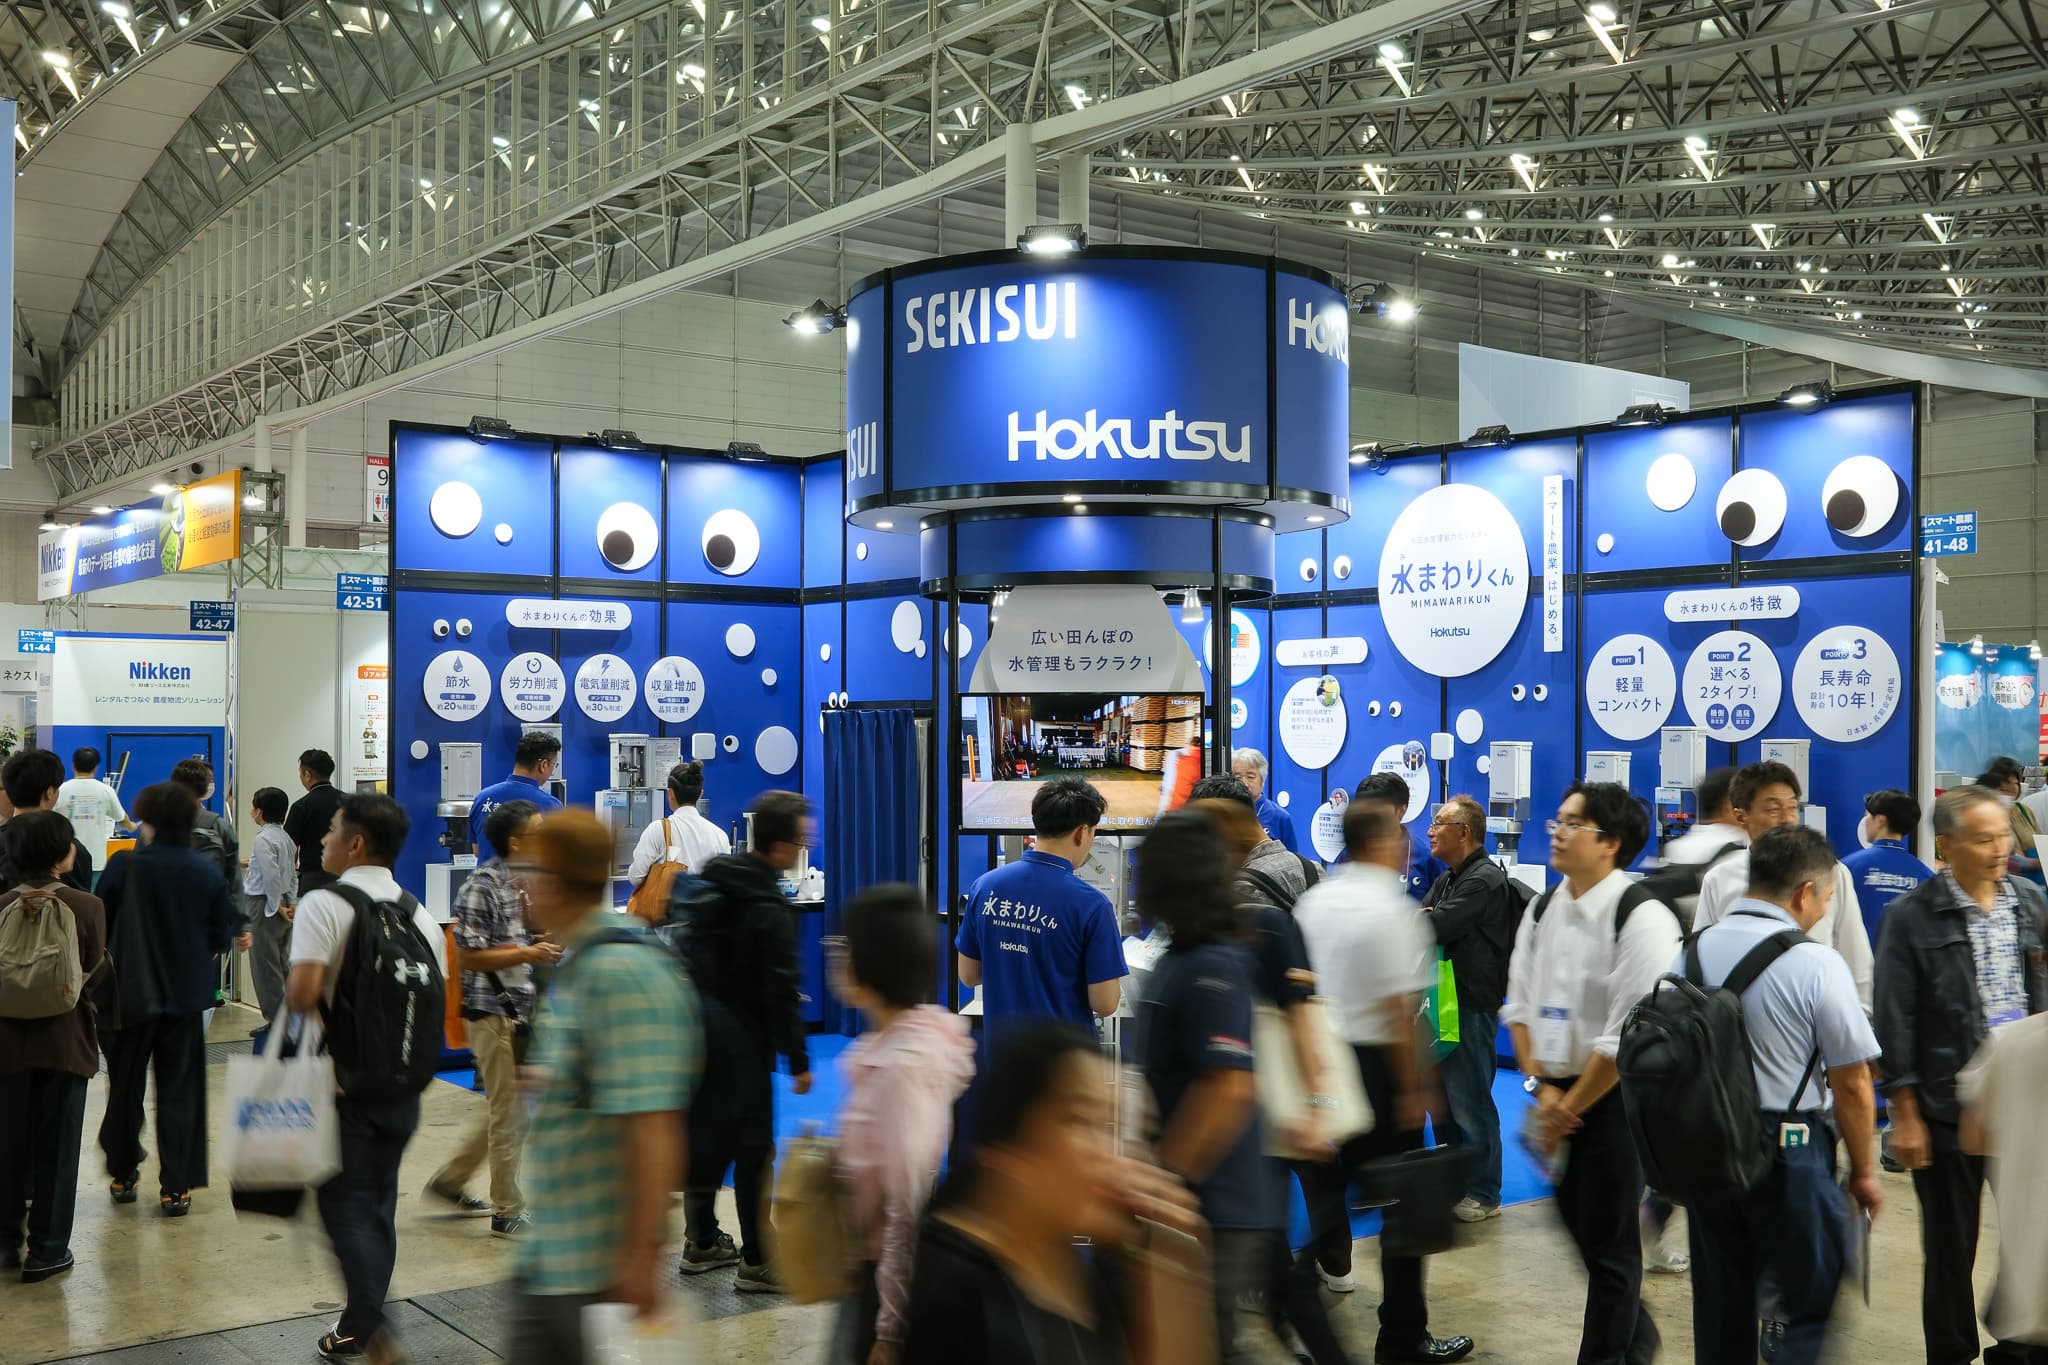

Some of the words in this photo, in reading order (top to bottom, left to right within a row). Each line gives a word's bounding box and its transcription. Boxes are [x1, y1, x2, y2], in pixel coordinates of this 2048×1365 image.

[906, 281, 1077, 354] SEKISUI
[1007, 407, 1251, 463] Hokutsu
[377, 469, 389, 486] 9
[1924, 537, 1968, 553] 41-48
[1390, 559, 1514, 594] 水まわりくん
[343, 595, 383, 609] 42-51
[1411, 594, 1491, 609] MIMAWARIKUN
[1680, 594, 1782, 614] 水まわりくんの特徴
[522, 607, 617, 624] 水まわりくんの効果
[195, 618, 231, 630] 42-47
[1430, 626, 1470, 638] Hokutsu
[1031, 629, 1134, 646] 広い田んぼの
[22, 642, 51, 652] 41-44
[1637, 646, 1645, 664] 1
[1737, 641, 1751, 661] 2
[1852, 638, 1867, 660] 3
[130, 661, 191, 680] Nikken
[1008, 656, 1153, 672] 水管理もラクラク!
[1710, 666, 1750, 681] 選べる
[1819, 668, 1872, 687] 長寿命
[445, 675, 471, 689] 節水
[509, 676, 559, 690] 労力削減
[579, 677, 630, 691] 電気量削減
[651, 679, 697, 692] 収量増加
[1615, 676, 1644, 693] 軽量
[1700, 684, 1756, 700] 2タイプ!
[1810, 691, 1825, 700] 設計
[1828, 691, 1875, 709] 10年!
[1598, 697, 1662, 712] コンパクト
[981, 894, 1058, 931] 水まわりくん
[1000, 940, 1029, 955] Hokutsu
